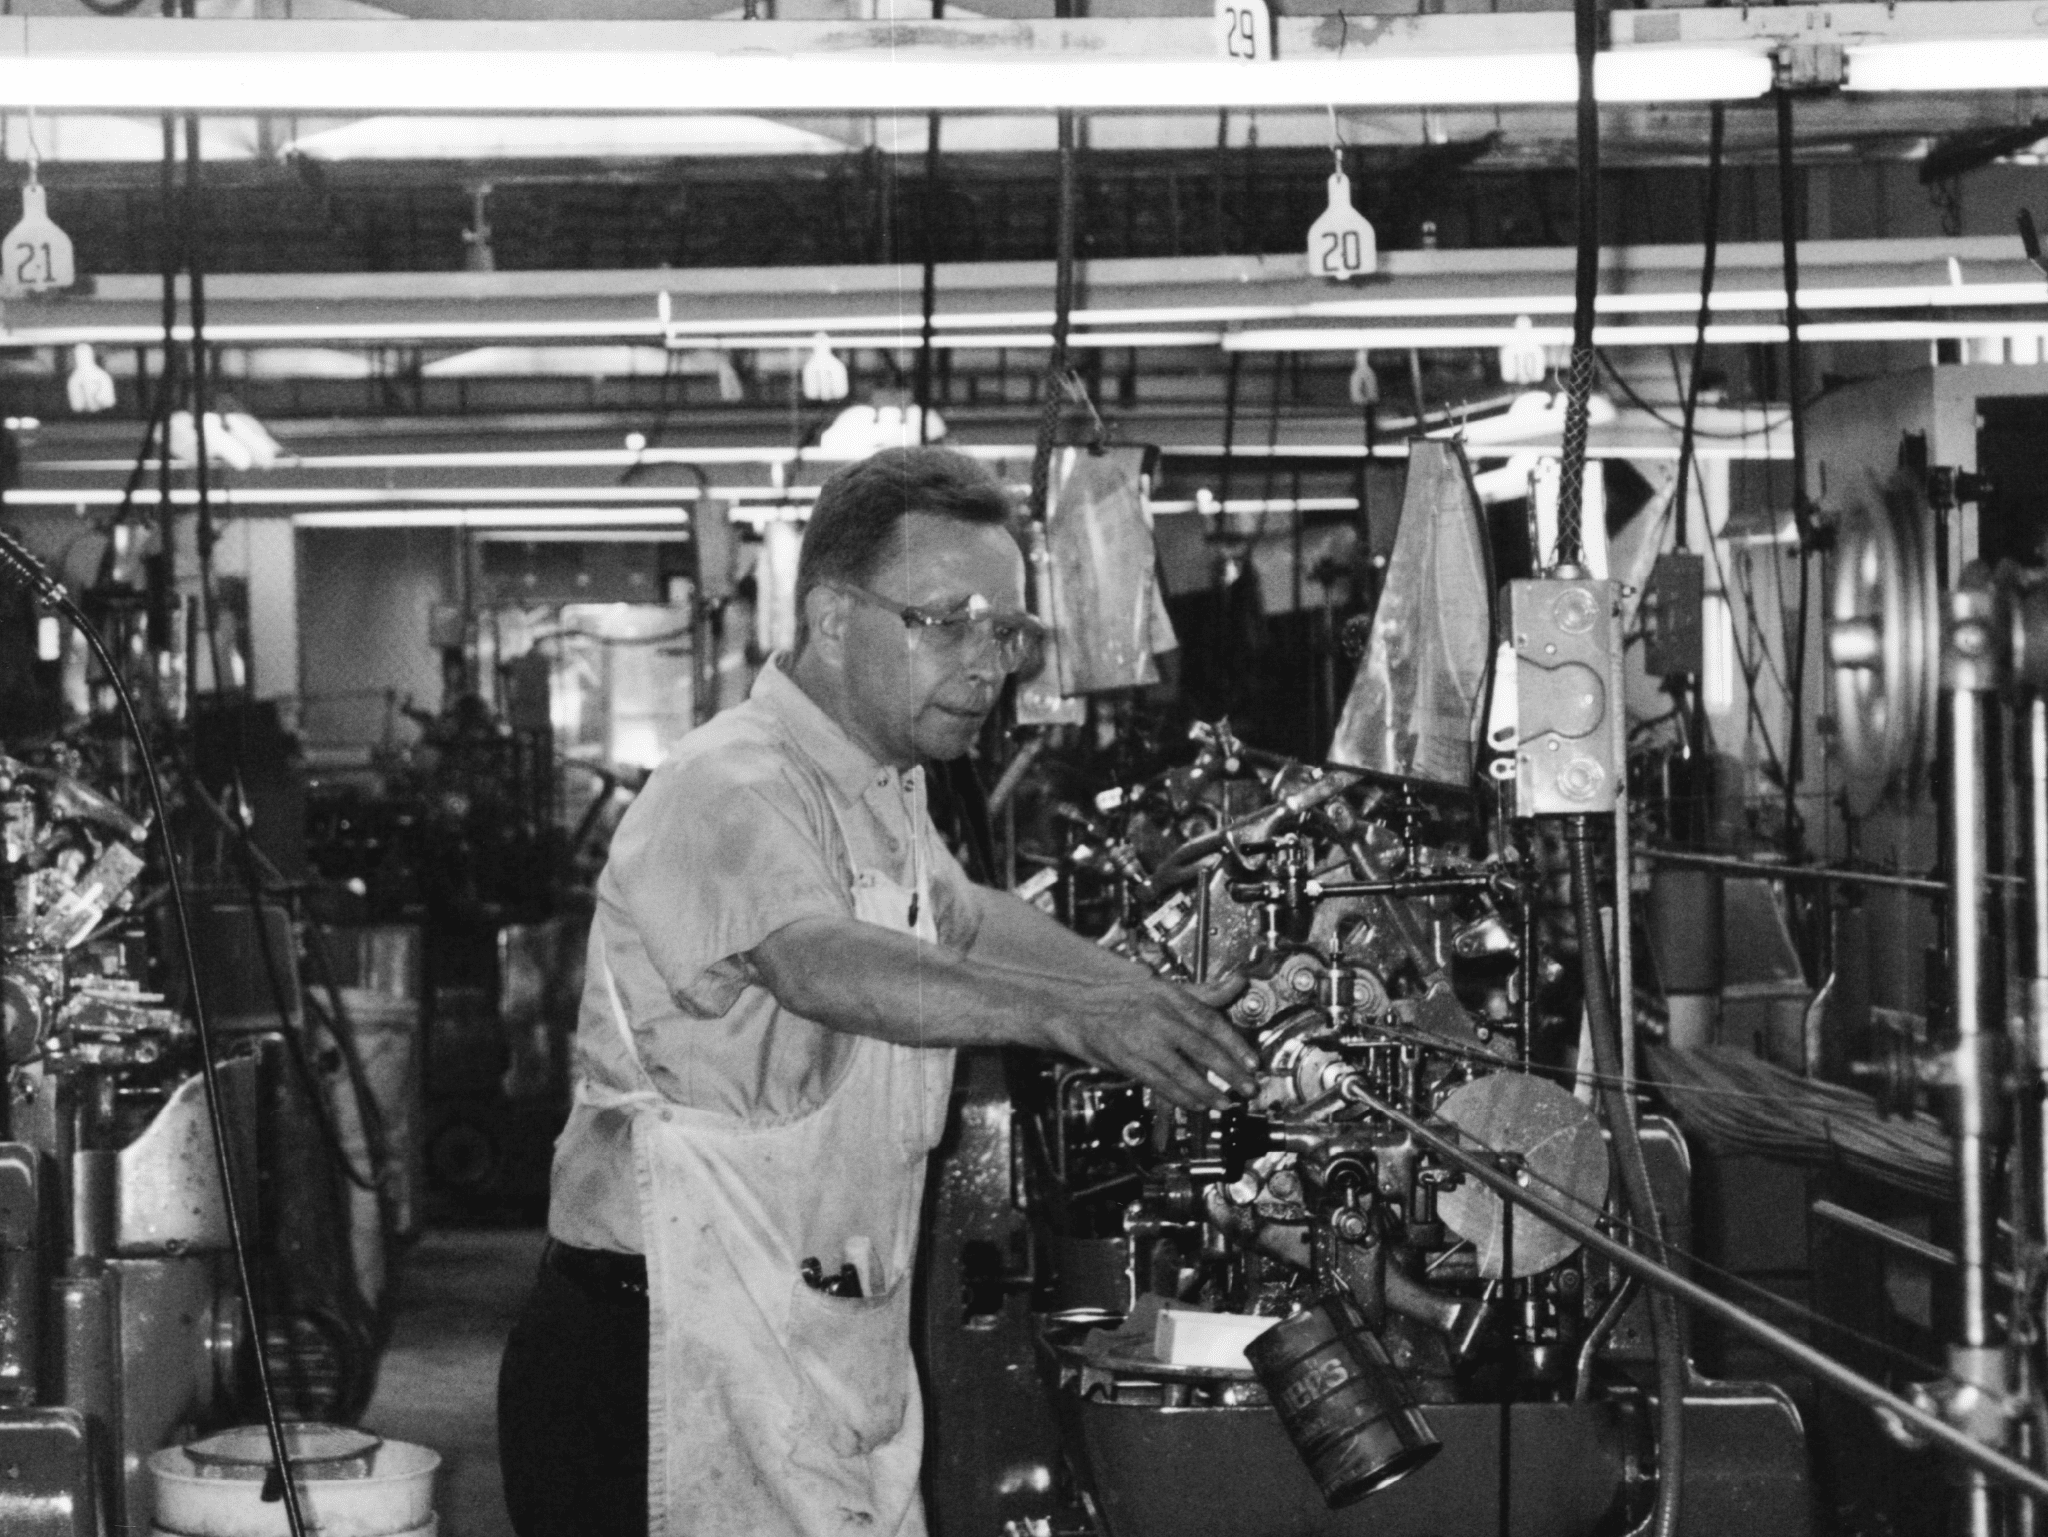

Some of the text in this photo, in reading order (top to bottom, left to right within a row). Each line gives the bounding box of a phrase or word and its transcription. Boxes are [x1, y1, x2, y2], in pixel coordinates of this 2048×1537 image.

[1225, 6, 1256, 60] 29
[15, 242, 57, 284] 21
[1321, 230, 1362, 272] 20
